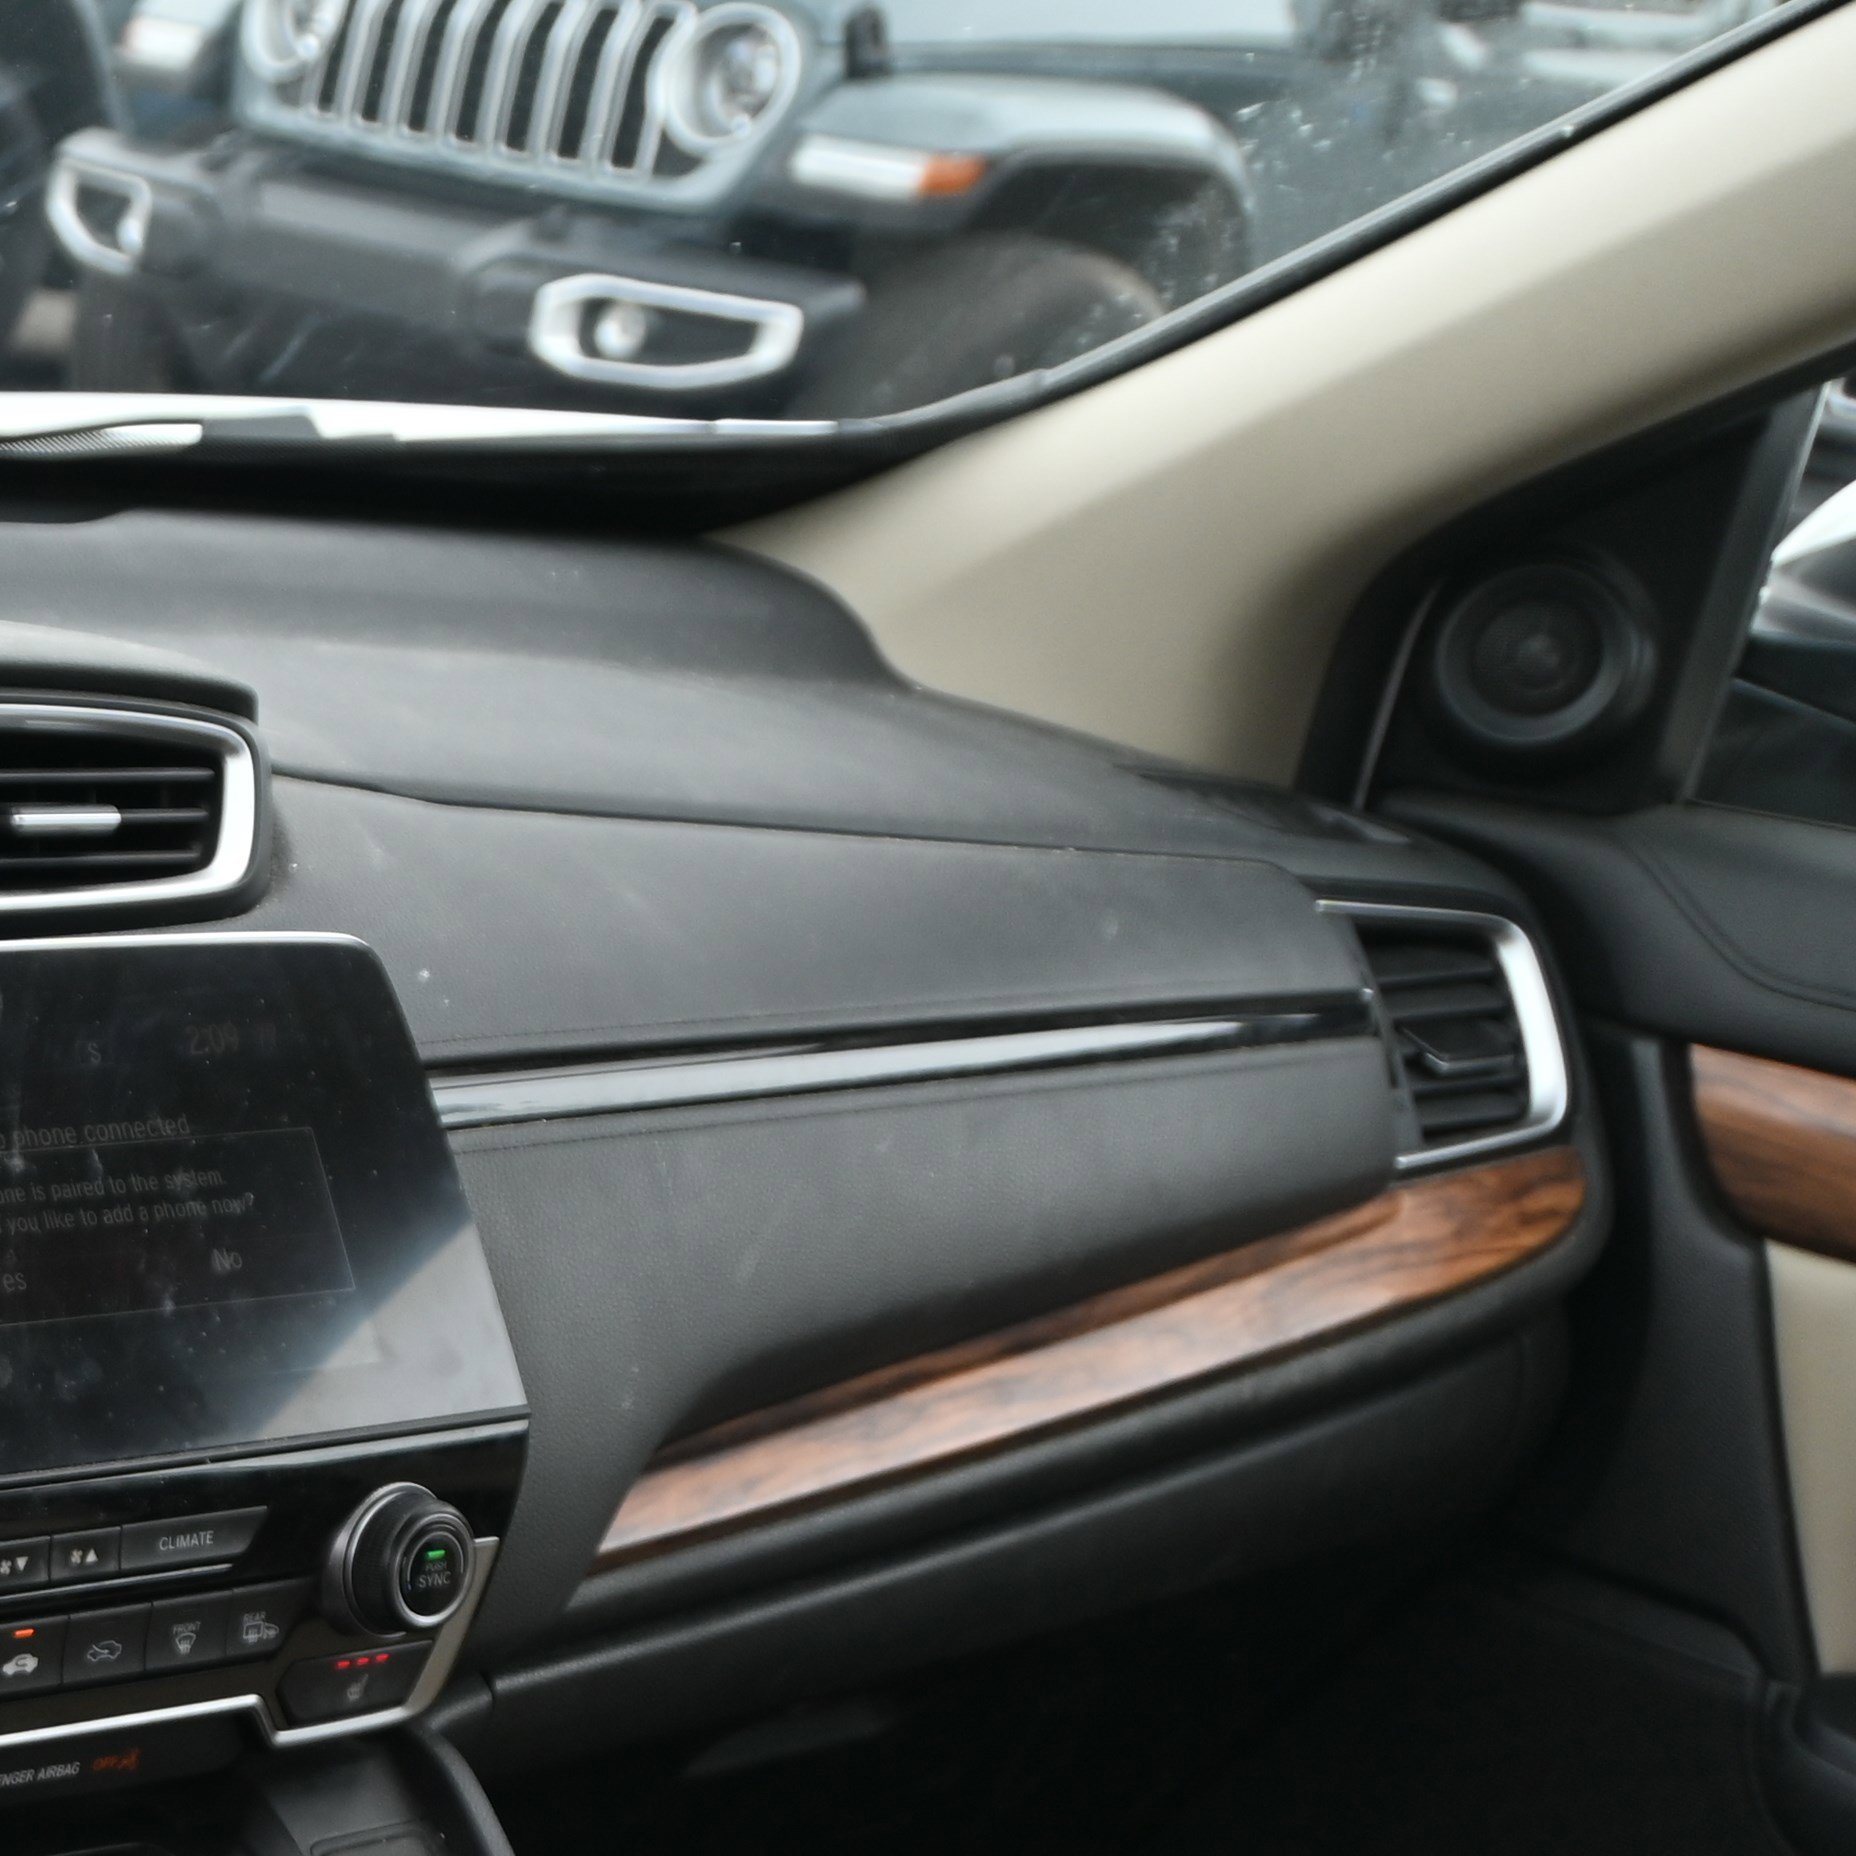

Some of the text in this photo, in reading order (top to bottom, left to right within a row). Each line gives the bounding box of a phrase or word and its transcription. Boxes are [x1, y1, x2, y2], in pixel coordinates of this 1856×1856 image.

[13, 1123, 78, 1152] phone
[83, 1114, 191, 1143] connected
[31, 1182, 46, 1202] is
[50, 1178, 105, 1203] paired
[108, 1175, 128, 1195] to
[130, 1173, 159, 1193] the
[6, 1215, 40, 1236] you
[43, 1209, 76, 1229] like
[79, 1207, 99, 1227] to
[103, 1203, 135, 1225] add
[139, 1205, 150, 1221] a
[153, 1199, 208, 1223] phone
[211, 1191, 255, 1217] now?
[210, 1247, 243, 1275] No
[158, 1529, 215, 1551] CLIMATE
[418, 1571, 452, 1589] SYNC
[172, 1620, 202, 1634] FRONT
[242, 1610, 268, 1623] REAR
[37, 1761, 81, 1782] AIRBAG
